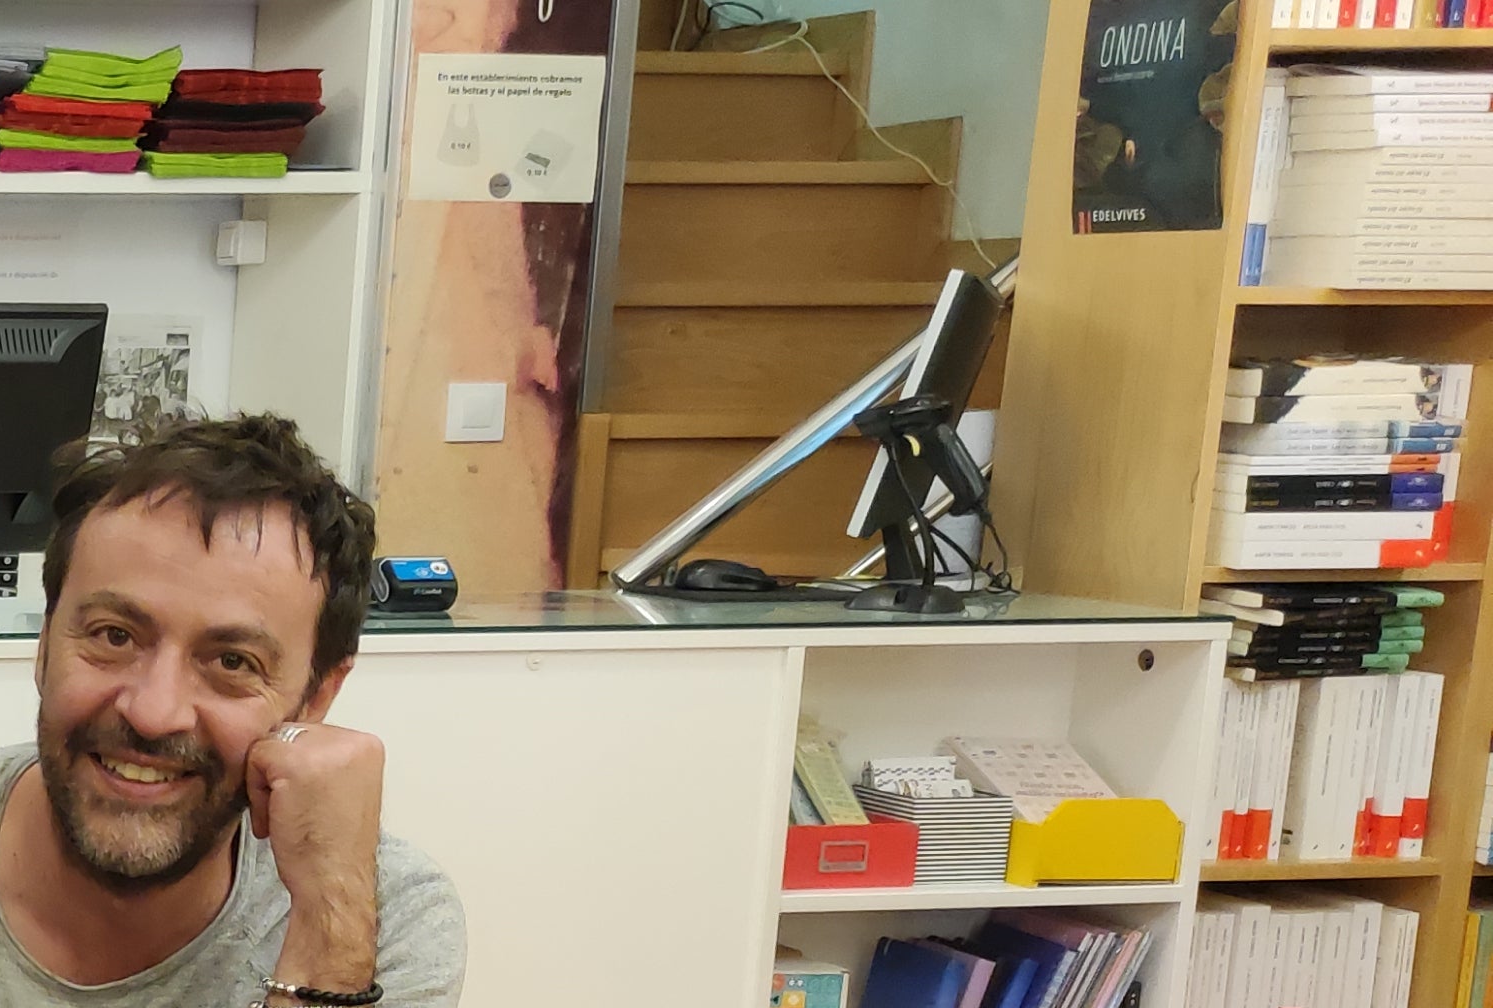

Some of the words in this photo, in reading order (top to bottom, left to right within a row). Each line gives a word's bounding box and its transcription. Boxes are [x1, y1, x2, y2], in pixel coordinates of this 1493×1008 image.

[1100, 17, 1186, 67] ONDINA
[438, 73, 449, 82] En
[450, 74, 469, 82] este
[540, 74, 583, 83] cobramos
[448, 86, 460, 95] las
[507, 87, 531, 97] papel
[532, 86, 544, 96] de
[1092, 208, 1146, 222] EDELVIVES
